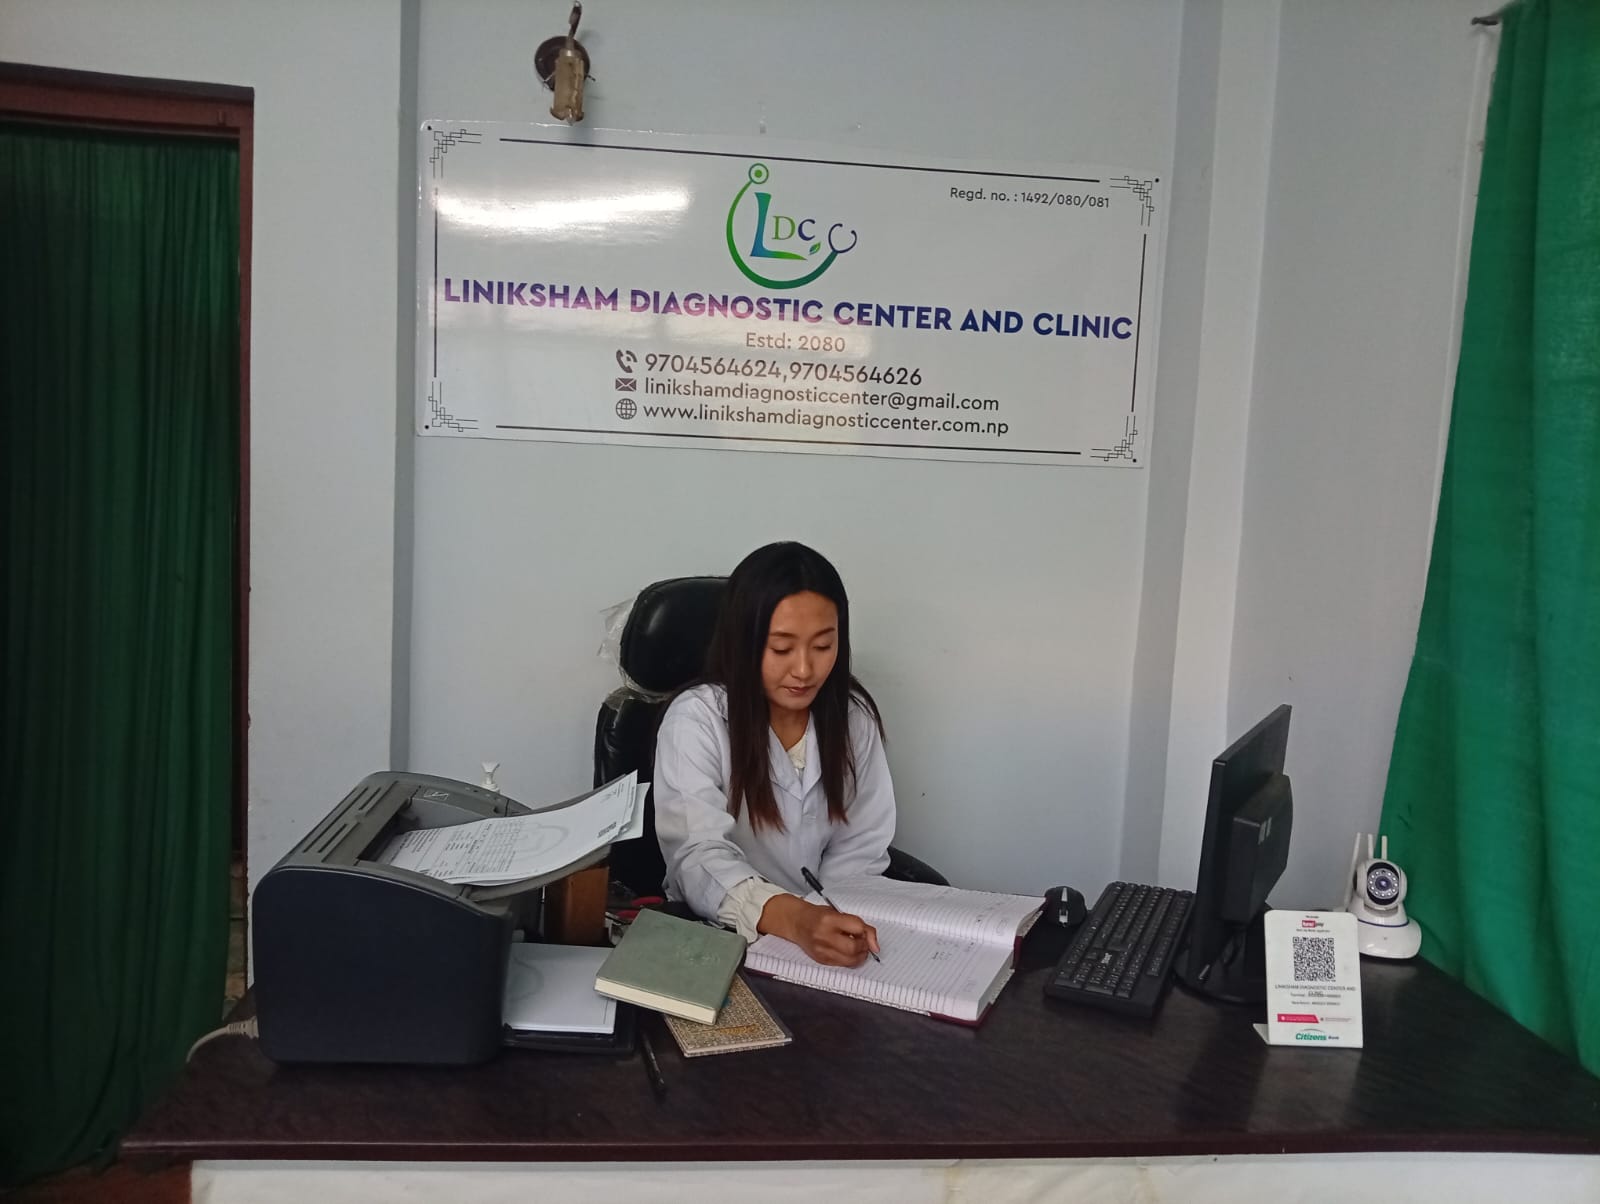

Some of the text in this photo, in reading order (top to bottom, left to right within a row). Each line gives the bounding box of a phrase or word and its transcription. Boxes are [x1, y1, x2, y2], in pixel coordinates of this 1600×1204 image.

[950, 187, 986, 202] Regd.
[1020, 191, 1110, 208] 1492/080/081
[444, 278, 1133, 340] LINIKSHAM DIAGNOSTIC CENTER AND CLINIC
[745, 332, 846, 352] Estd: 2080
[645, 353, 922, 386] 9704564624,9704564626
[645, 377, 999, 411] linikshamdiagnosticcenter@gmail.com
[643, 403, 1009, 436] www.linikshamdiagnosticcenter.com.np
[1295, 1033, 1327, 1041] Citizens
